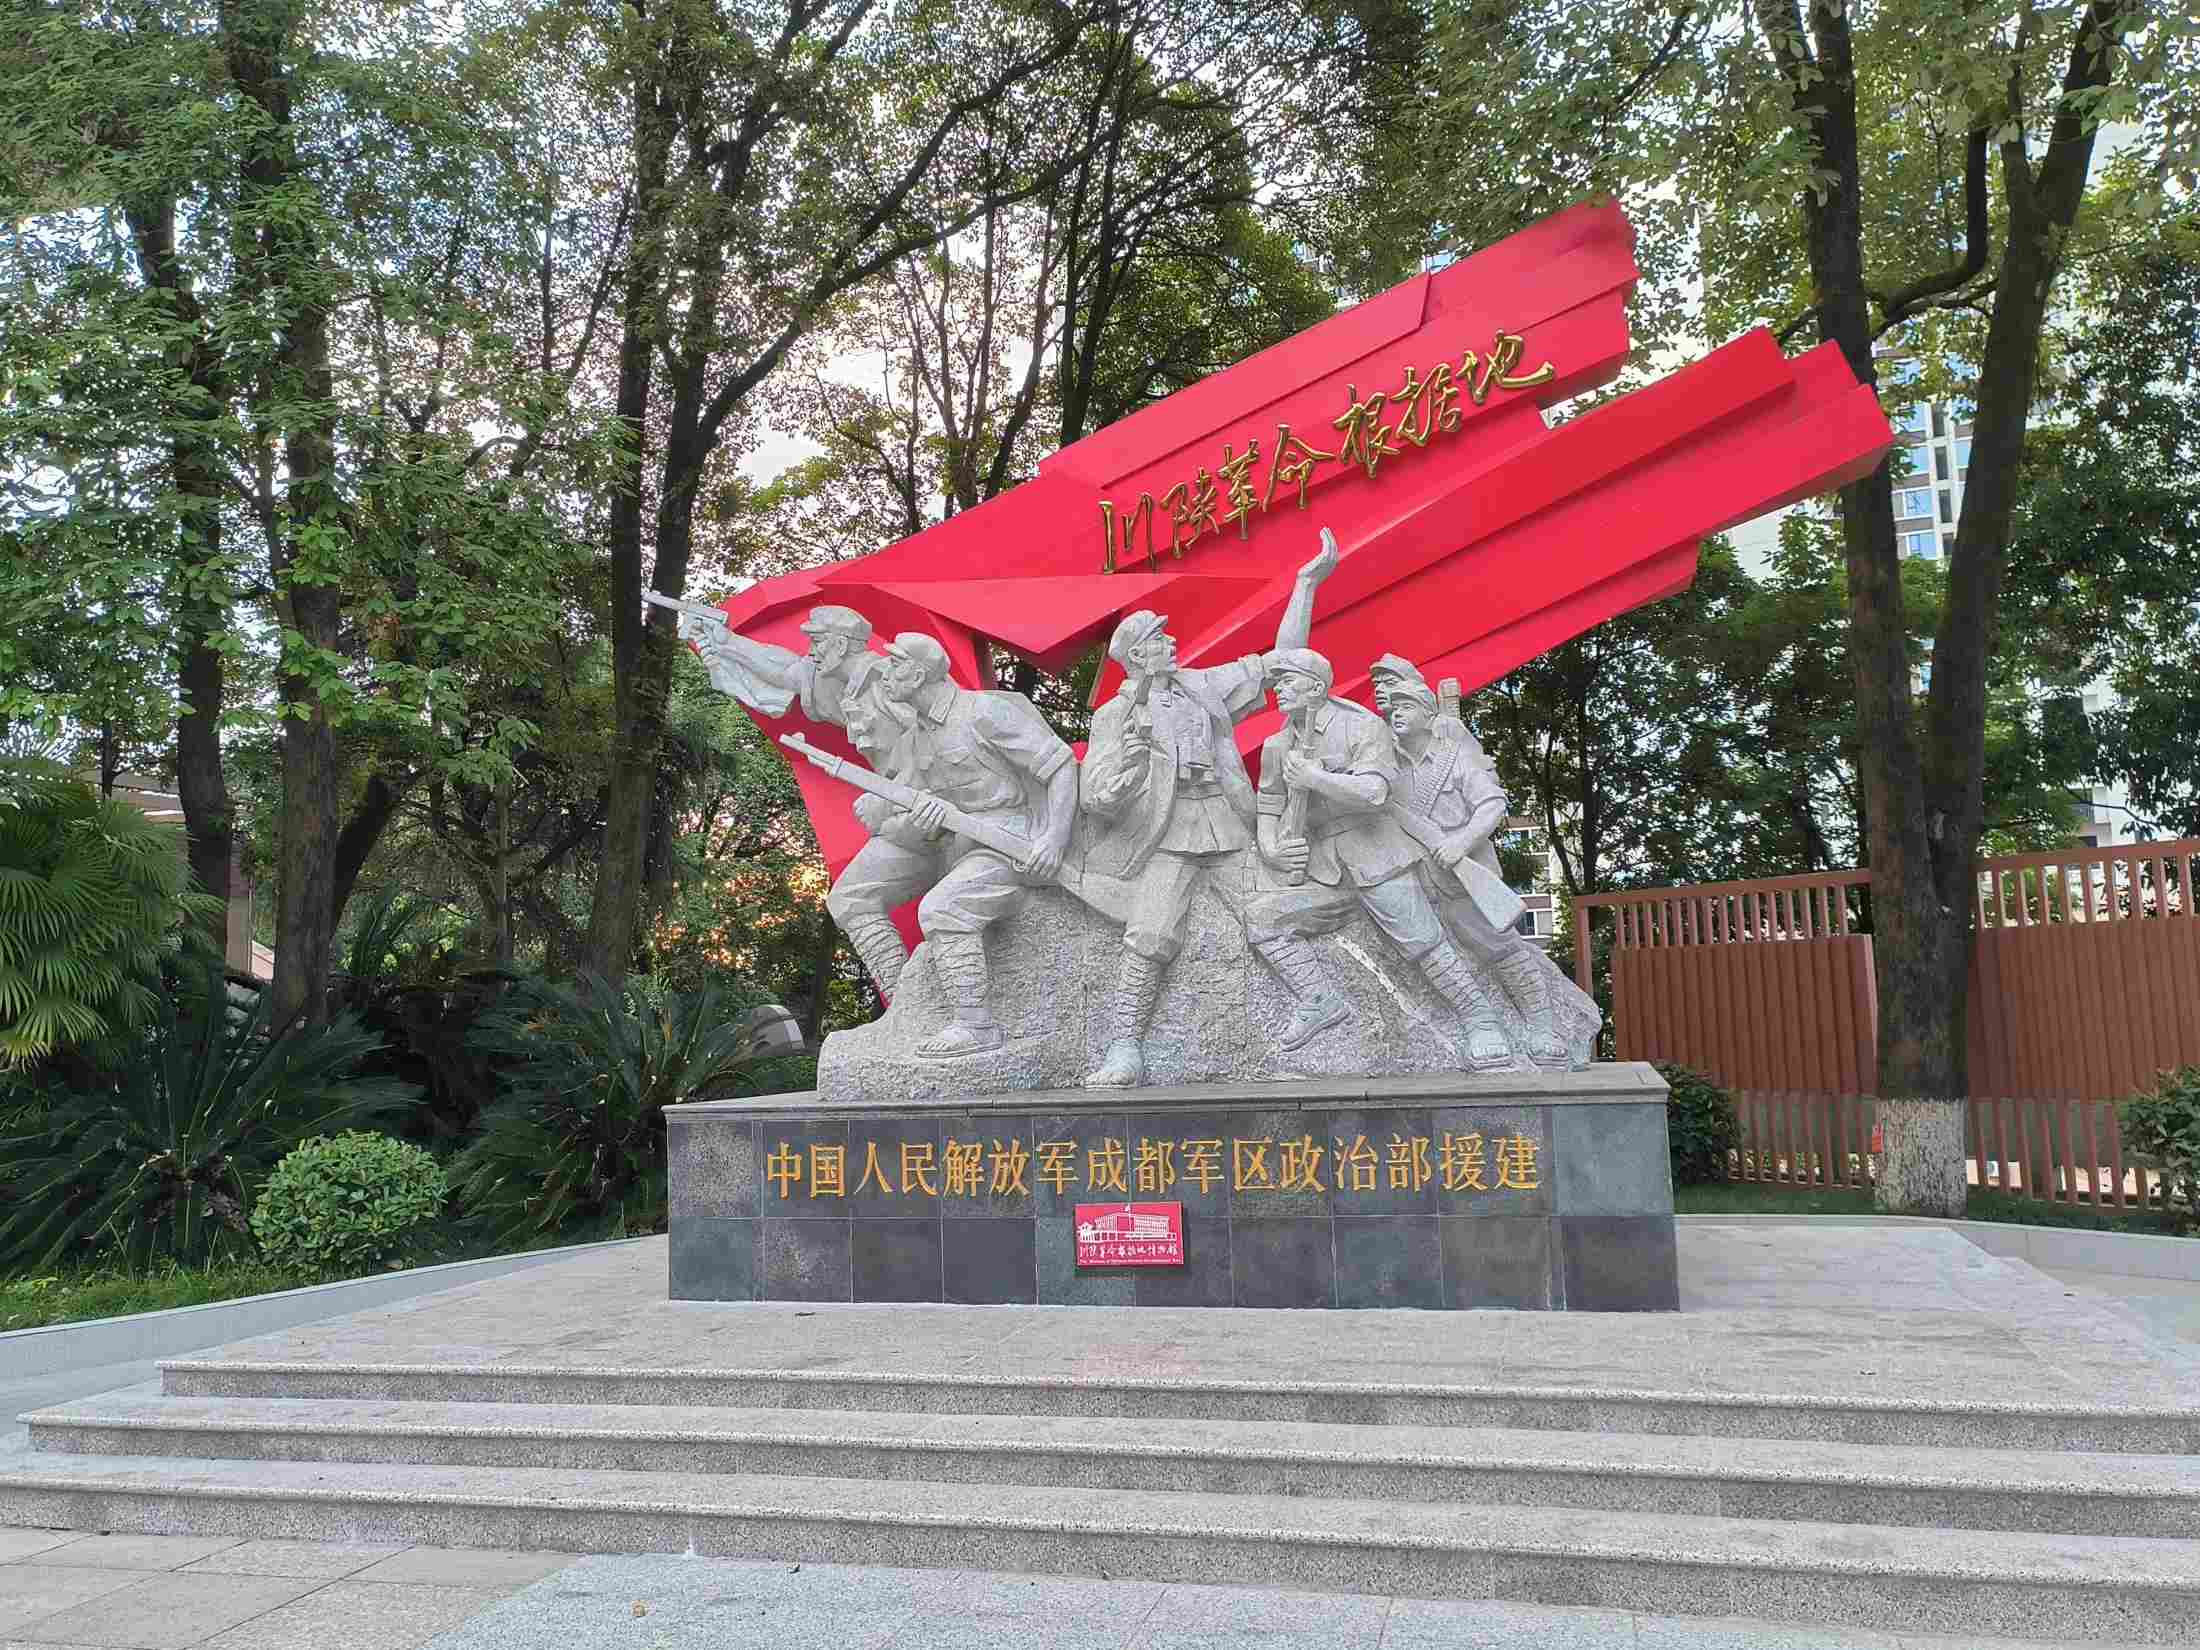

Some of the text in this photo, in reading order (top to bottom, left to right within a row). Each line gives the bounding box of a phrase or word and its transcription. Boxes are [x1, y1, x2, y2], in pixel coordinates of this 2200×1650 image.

[1098, 329, 1555, 575] 川陕革命根据地
[766, 1133, 1541, 1199] 中国人民解放军成都军区政治部援建
